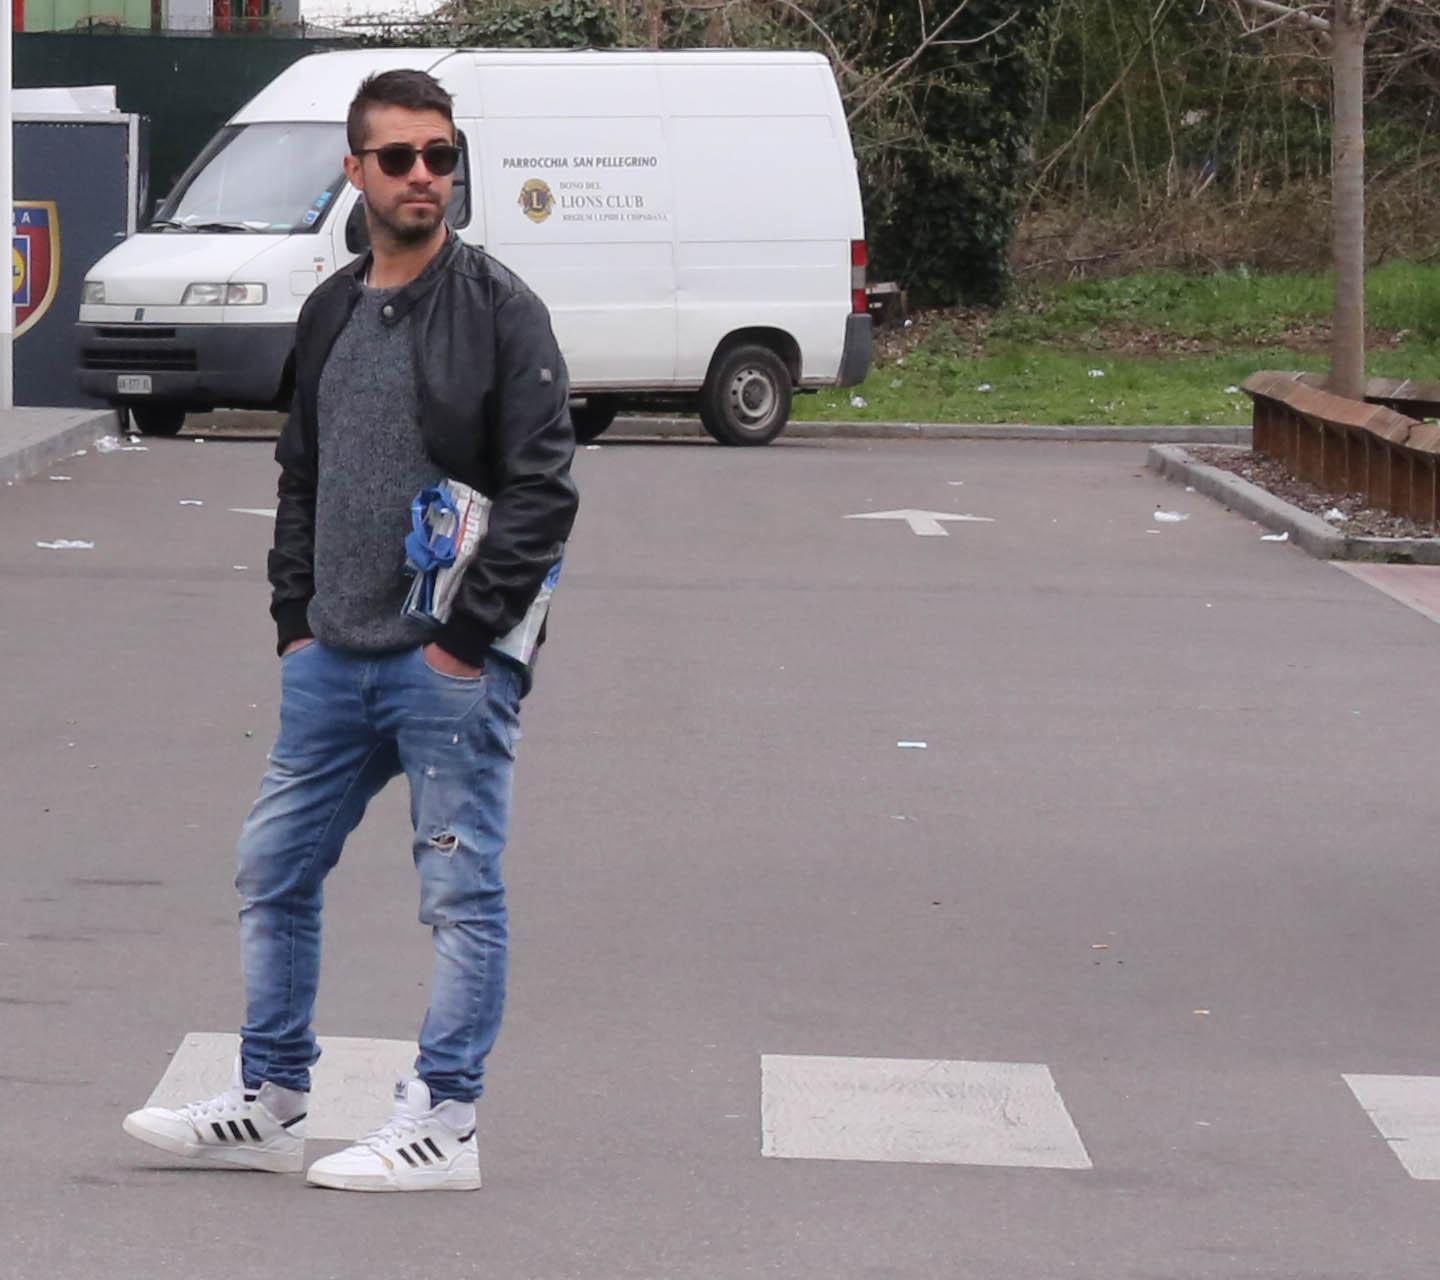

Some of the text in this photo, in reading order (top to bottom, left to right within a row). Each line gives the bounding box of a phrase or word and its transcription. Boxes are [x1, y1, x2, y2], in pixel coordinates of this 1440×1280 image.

[502, 156, 658, 168] PARROCCHIA SAN PELLEGRINO
[561, 195, 645, 209] LIONS CLUB
